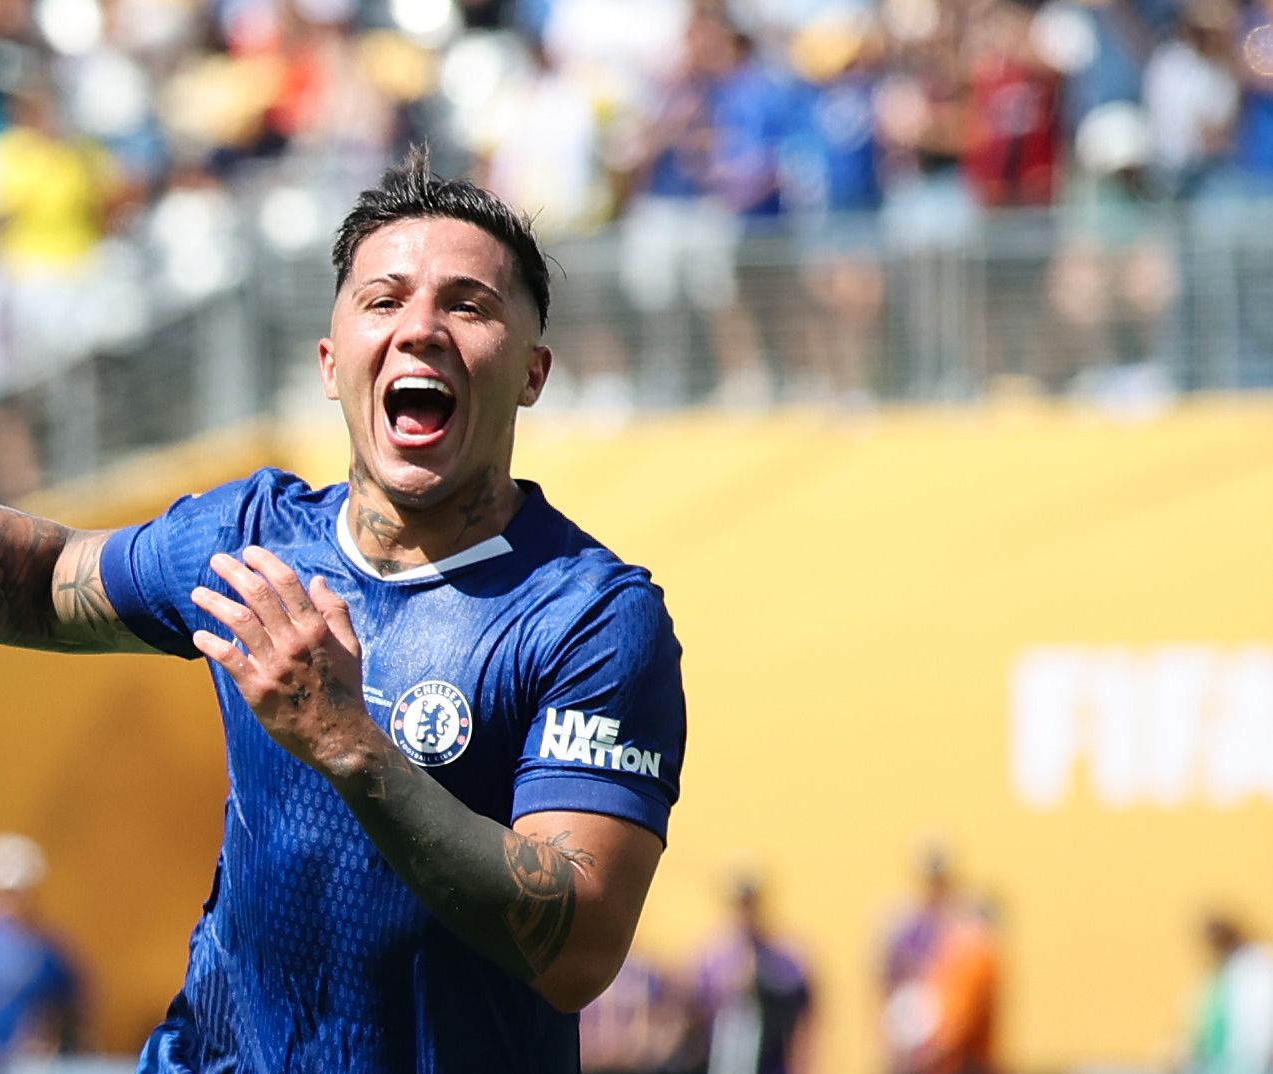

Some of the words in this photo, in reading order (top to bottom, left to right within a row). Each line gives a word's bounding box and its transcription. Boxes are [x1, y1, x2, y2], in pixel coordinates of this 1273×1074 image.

[414, 684, 461, 708] CHELSEA
[544, 707, 621, 745] LIVE
[539, 734, 662, 778] NATION
